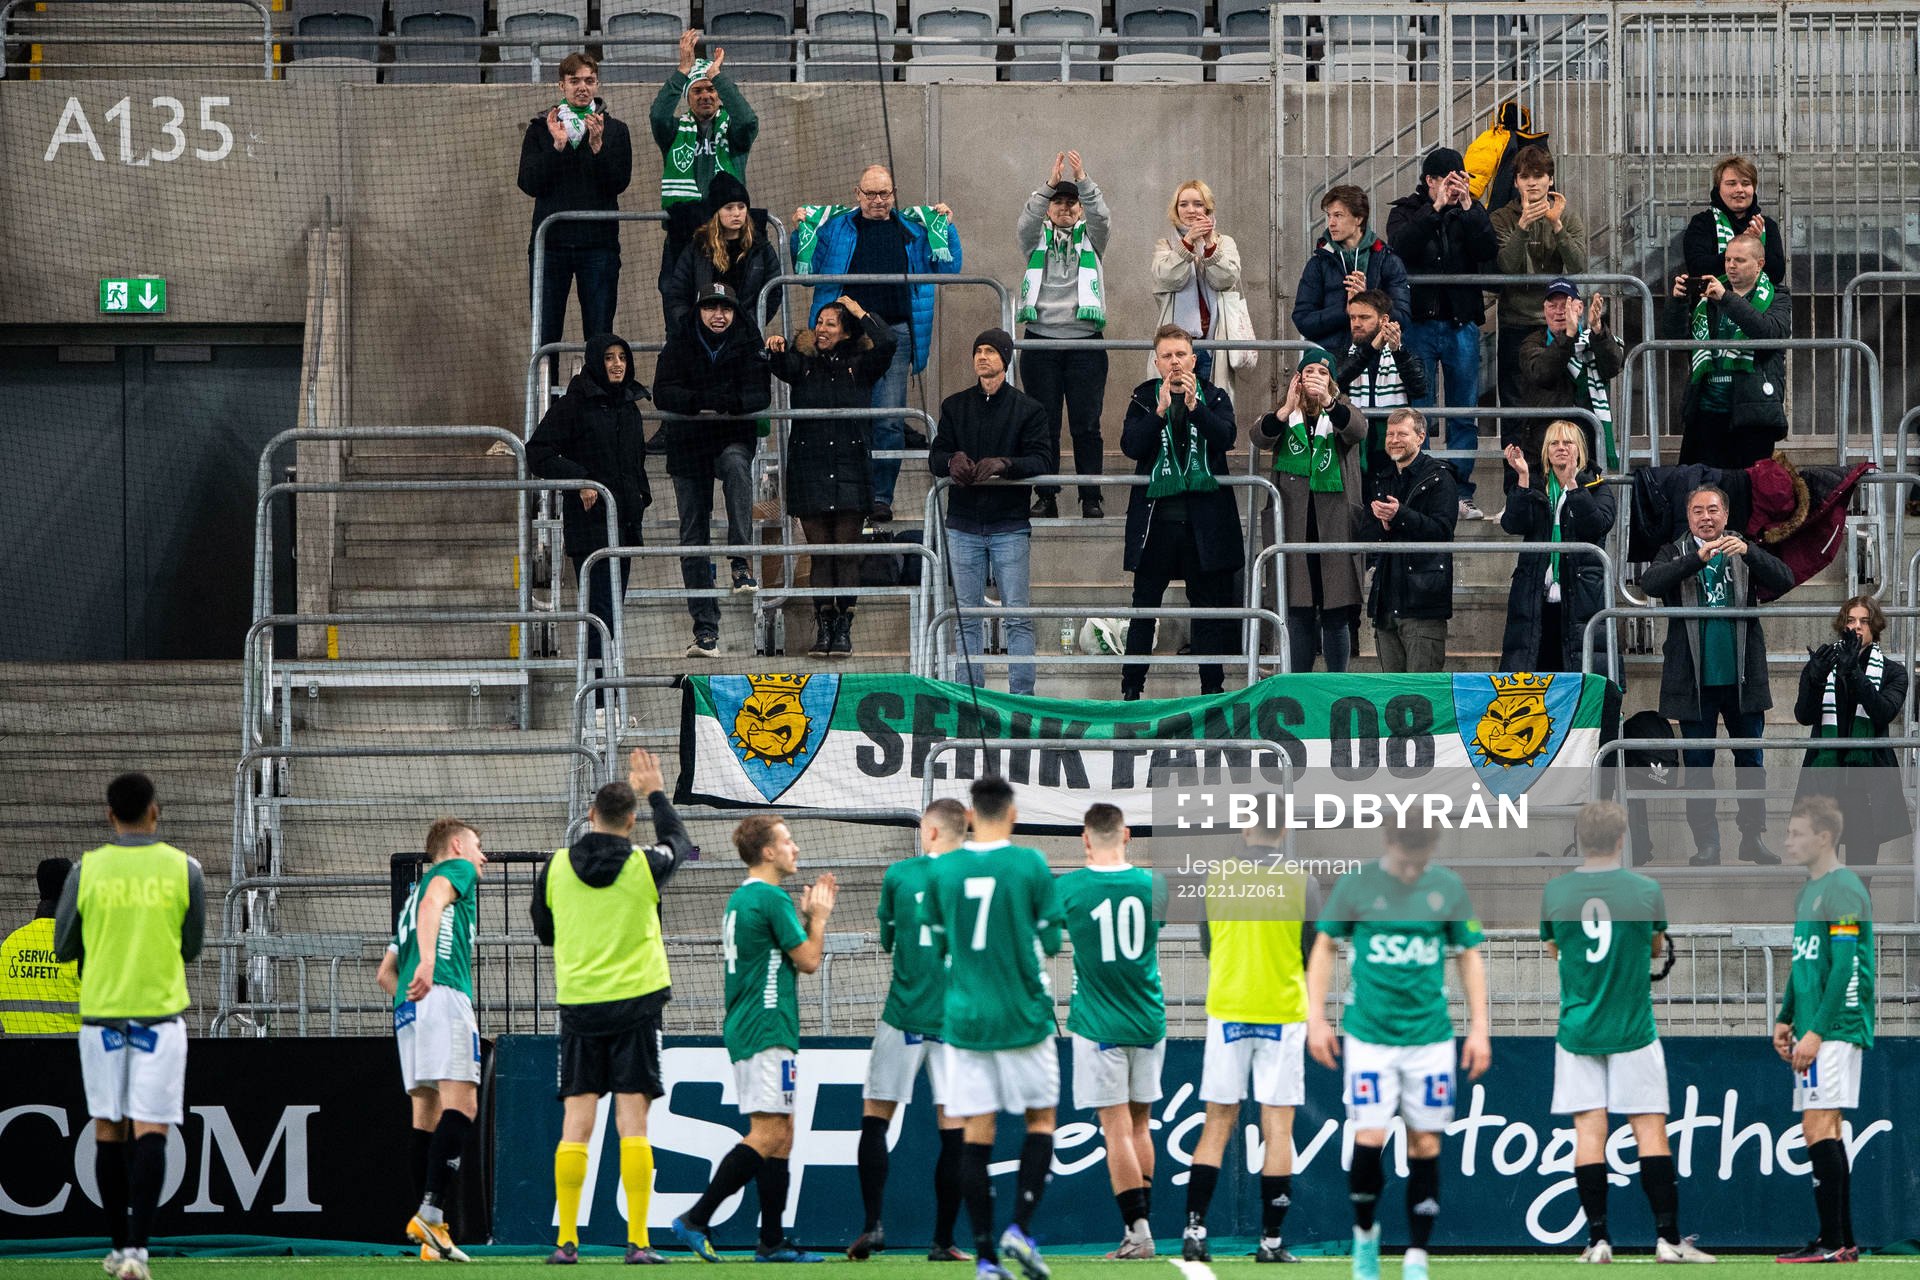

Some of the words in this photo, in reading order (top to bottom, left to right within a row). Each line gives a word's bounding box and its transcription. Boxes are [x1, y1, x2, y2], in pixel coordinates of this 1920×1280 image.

[44, 96, 234, 163] A135
[1111, 694, 1308, 789] FANS
[1330, 694, 1436, 782] 08
[94, 877, 176, 908] BRAGE
[964, 876, 997, 950] 7
[1089, 895, 1146, 963] 10
[1366, 933, 1441, 966] SSAB
[1580, 897, 1613, 963] 9
[20, 965, 60, 979] SAFETY
[1444, 1083, 1894, 1245] together
